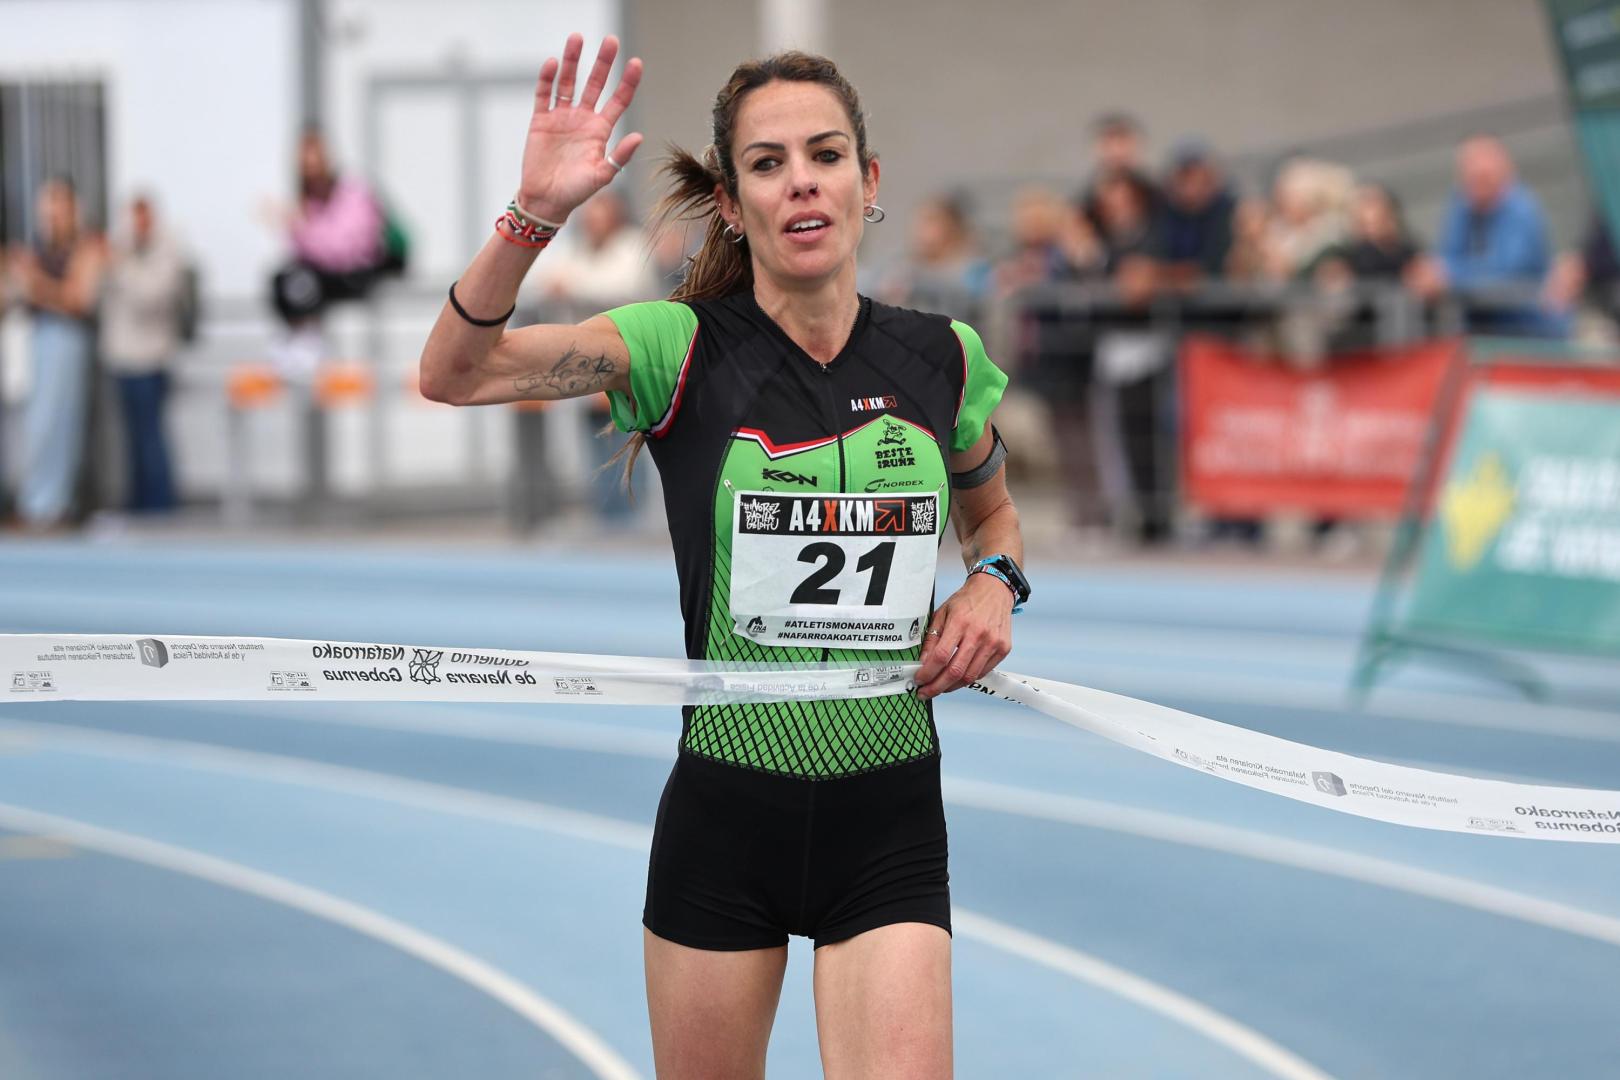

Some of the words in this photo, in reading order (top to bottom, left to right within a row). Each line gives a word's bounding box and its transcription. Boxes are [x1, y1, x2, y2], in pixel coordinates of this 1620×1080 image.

[851, 396, 885, 412] A4XKM
[875, 447, 913, 460] BESTE
[883, 480, 924, 488] NORDEX
[789, 500, 875, 532] A4XKM
[789, 541, 896, 606] 21
[784, 620, 895, 630] #ATLETISMONAVARRO
[777, 632, 903, 642] #NAFARROAKOATLETISMOA
